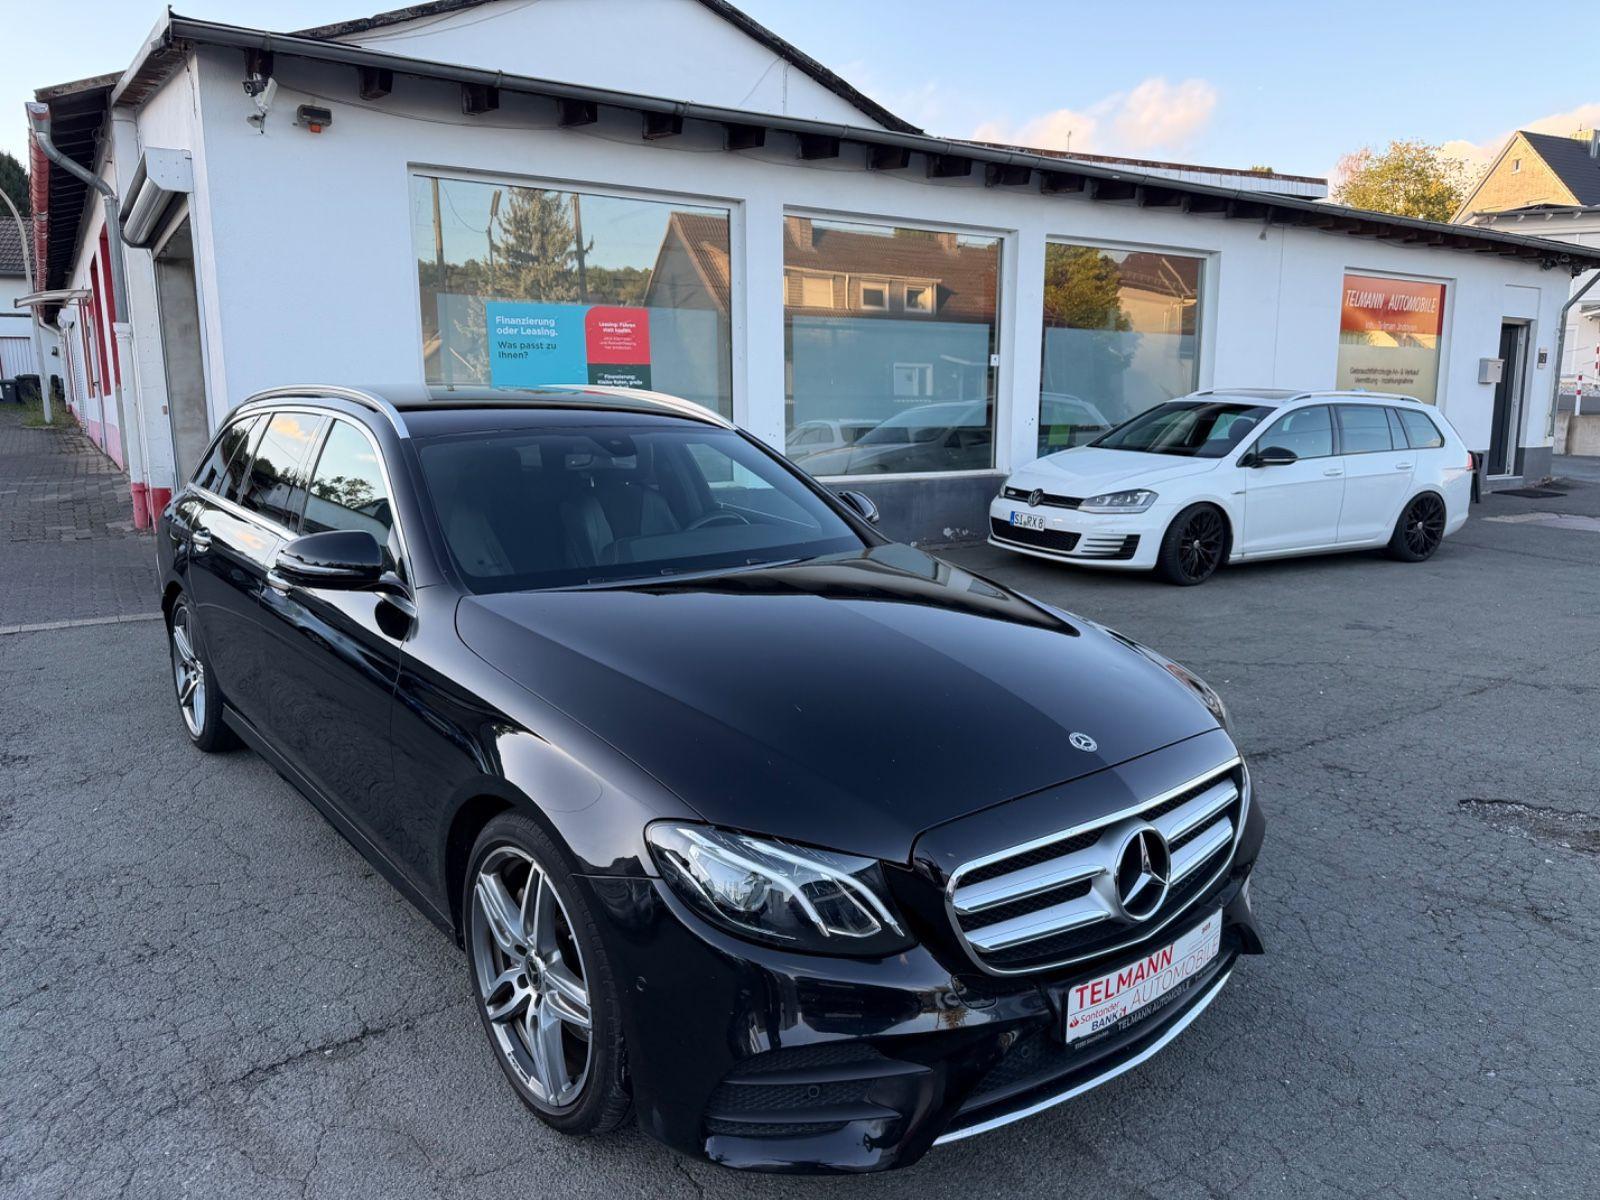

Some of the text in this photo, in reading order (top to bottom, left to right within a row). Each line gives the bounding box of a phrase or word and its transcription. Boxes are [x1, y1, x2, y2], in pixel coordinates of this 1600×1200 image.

[1345, 289, 1437, 313] TELMANN AUTOMOBILE
[495, 316, 556, 327] Finanzierung
[496, 326, 559, 337] oder Leasing.
[498, 341, 518, 350] Was
[520, 342, 544, 351] passt
[498, 351, 529, 359] Ihnen?
[1014, 513, 1023, 525] SI
[1075, 943, 1174, 1009] TELMANN
[1130, 933, 1220, 1010] AUTOMOBILE
[1080, 1001, 1120, 1025] Santander
[1091, 1009, 1119, 1031] BANK
